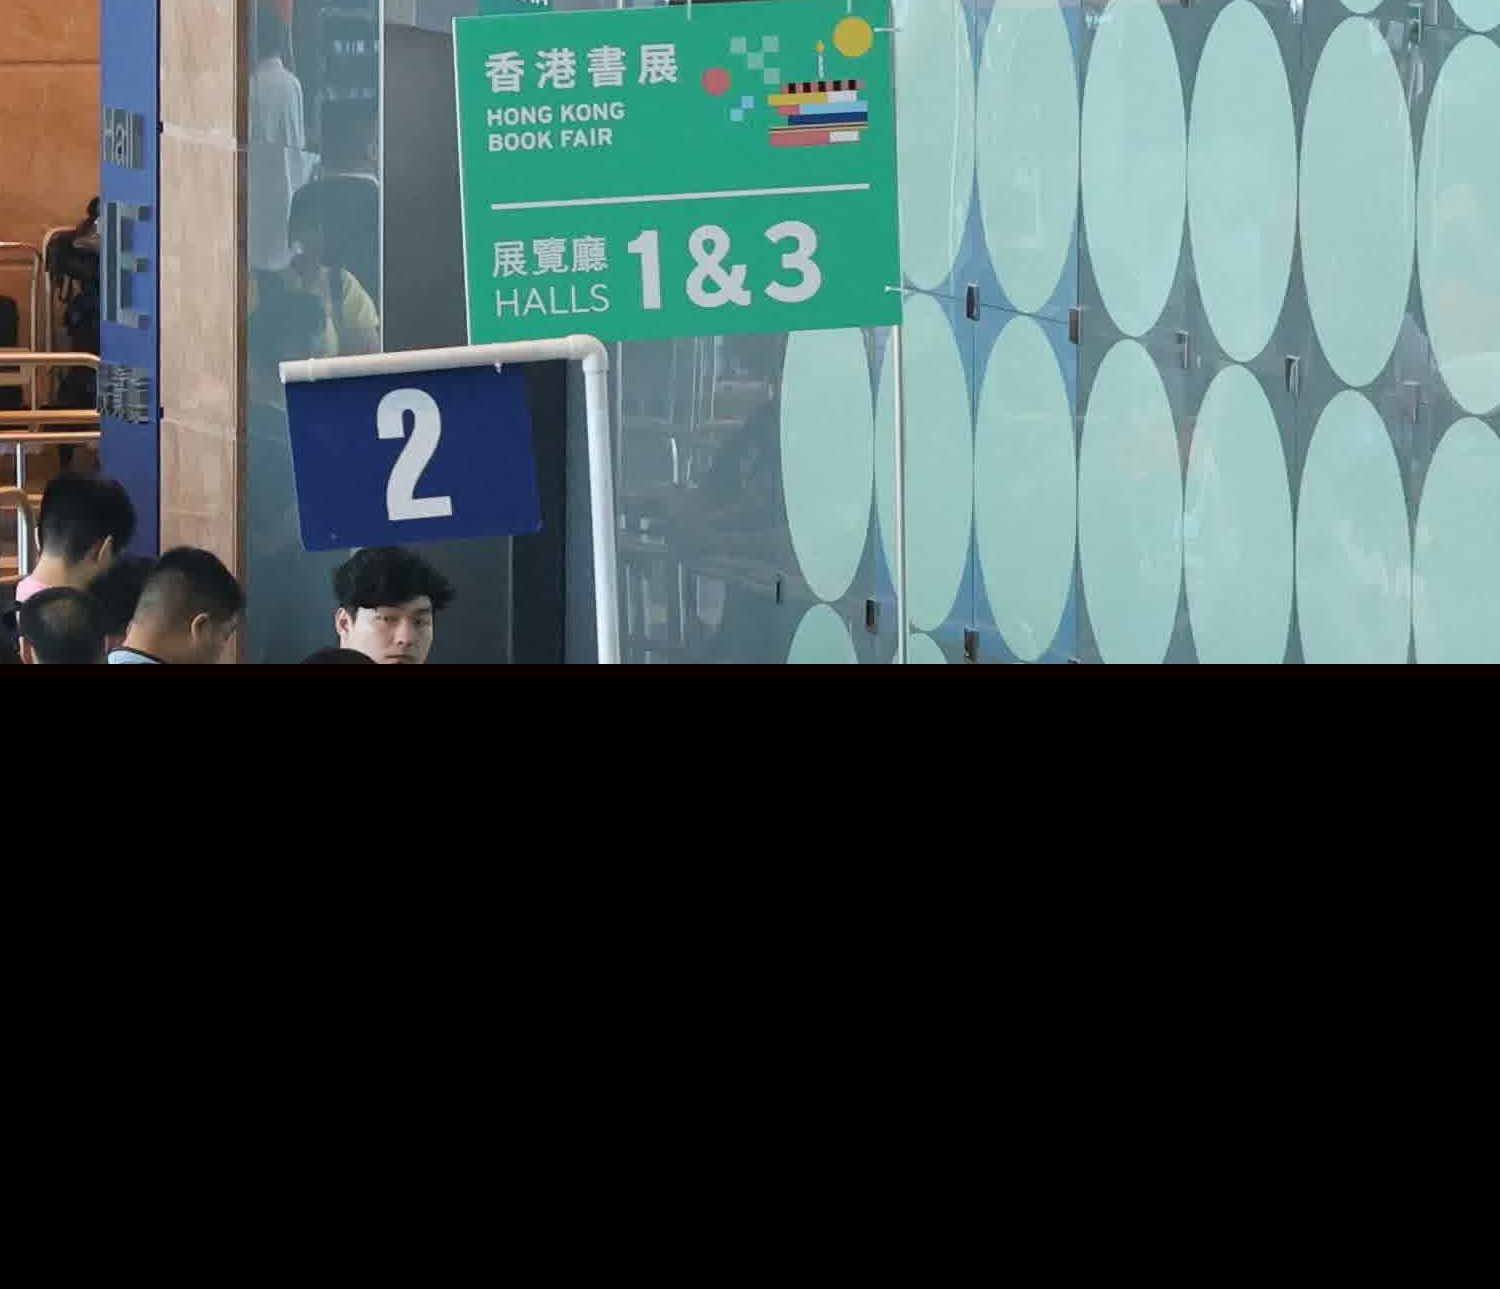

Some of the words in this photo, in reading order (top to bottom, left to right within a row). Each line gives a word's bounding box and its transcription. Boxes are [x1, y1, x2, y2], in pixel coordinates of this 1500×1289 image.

[484, 43, 679, 94] 香港書展
[486, 107, 553, 128] HONG
[560, 102, 626, 123] KONG
[488, 130, 554, 152] BOOK
[560, 127, 614, 148] FAIR
[492, 235, 610, 279] 展覽廳
[495, 283, 611, 318] HALLS
[375, 387, 453, 521] 2
